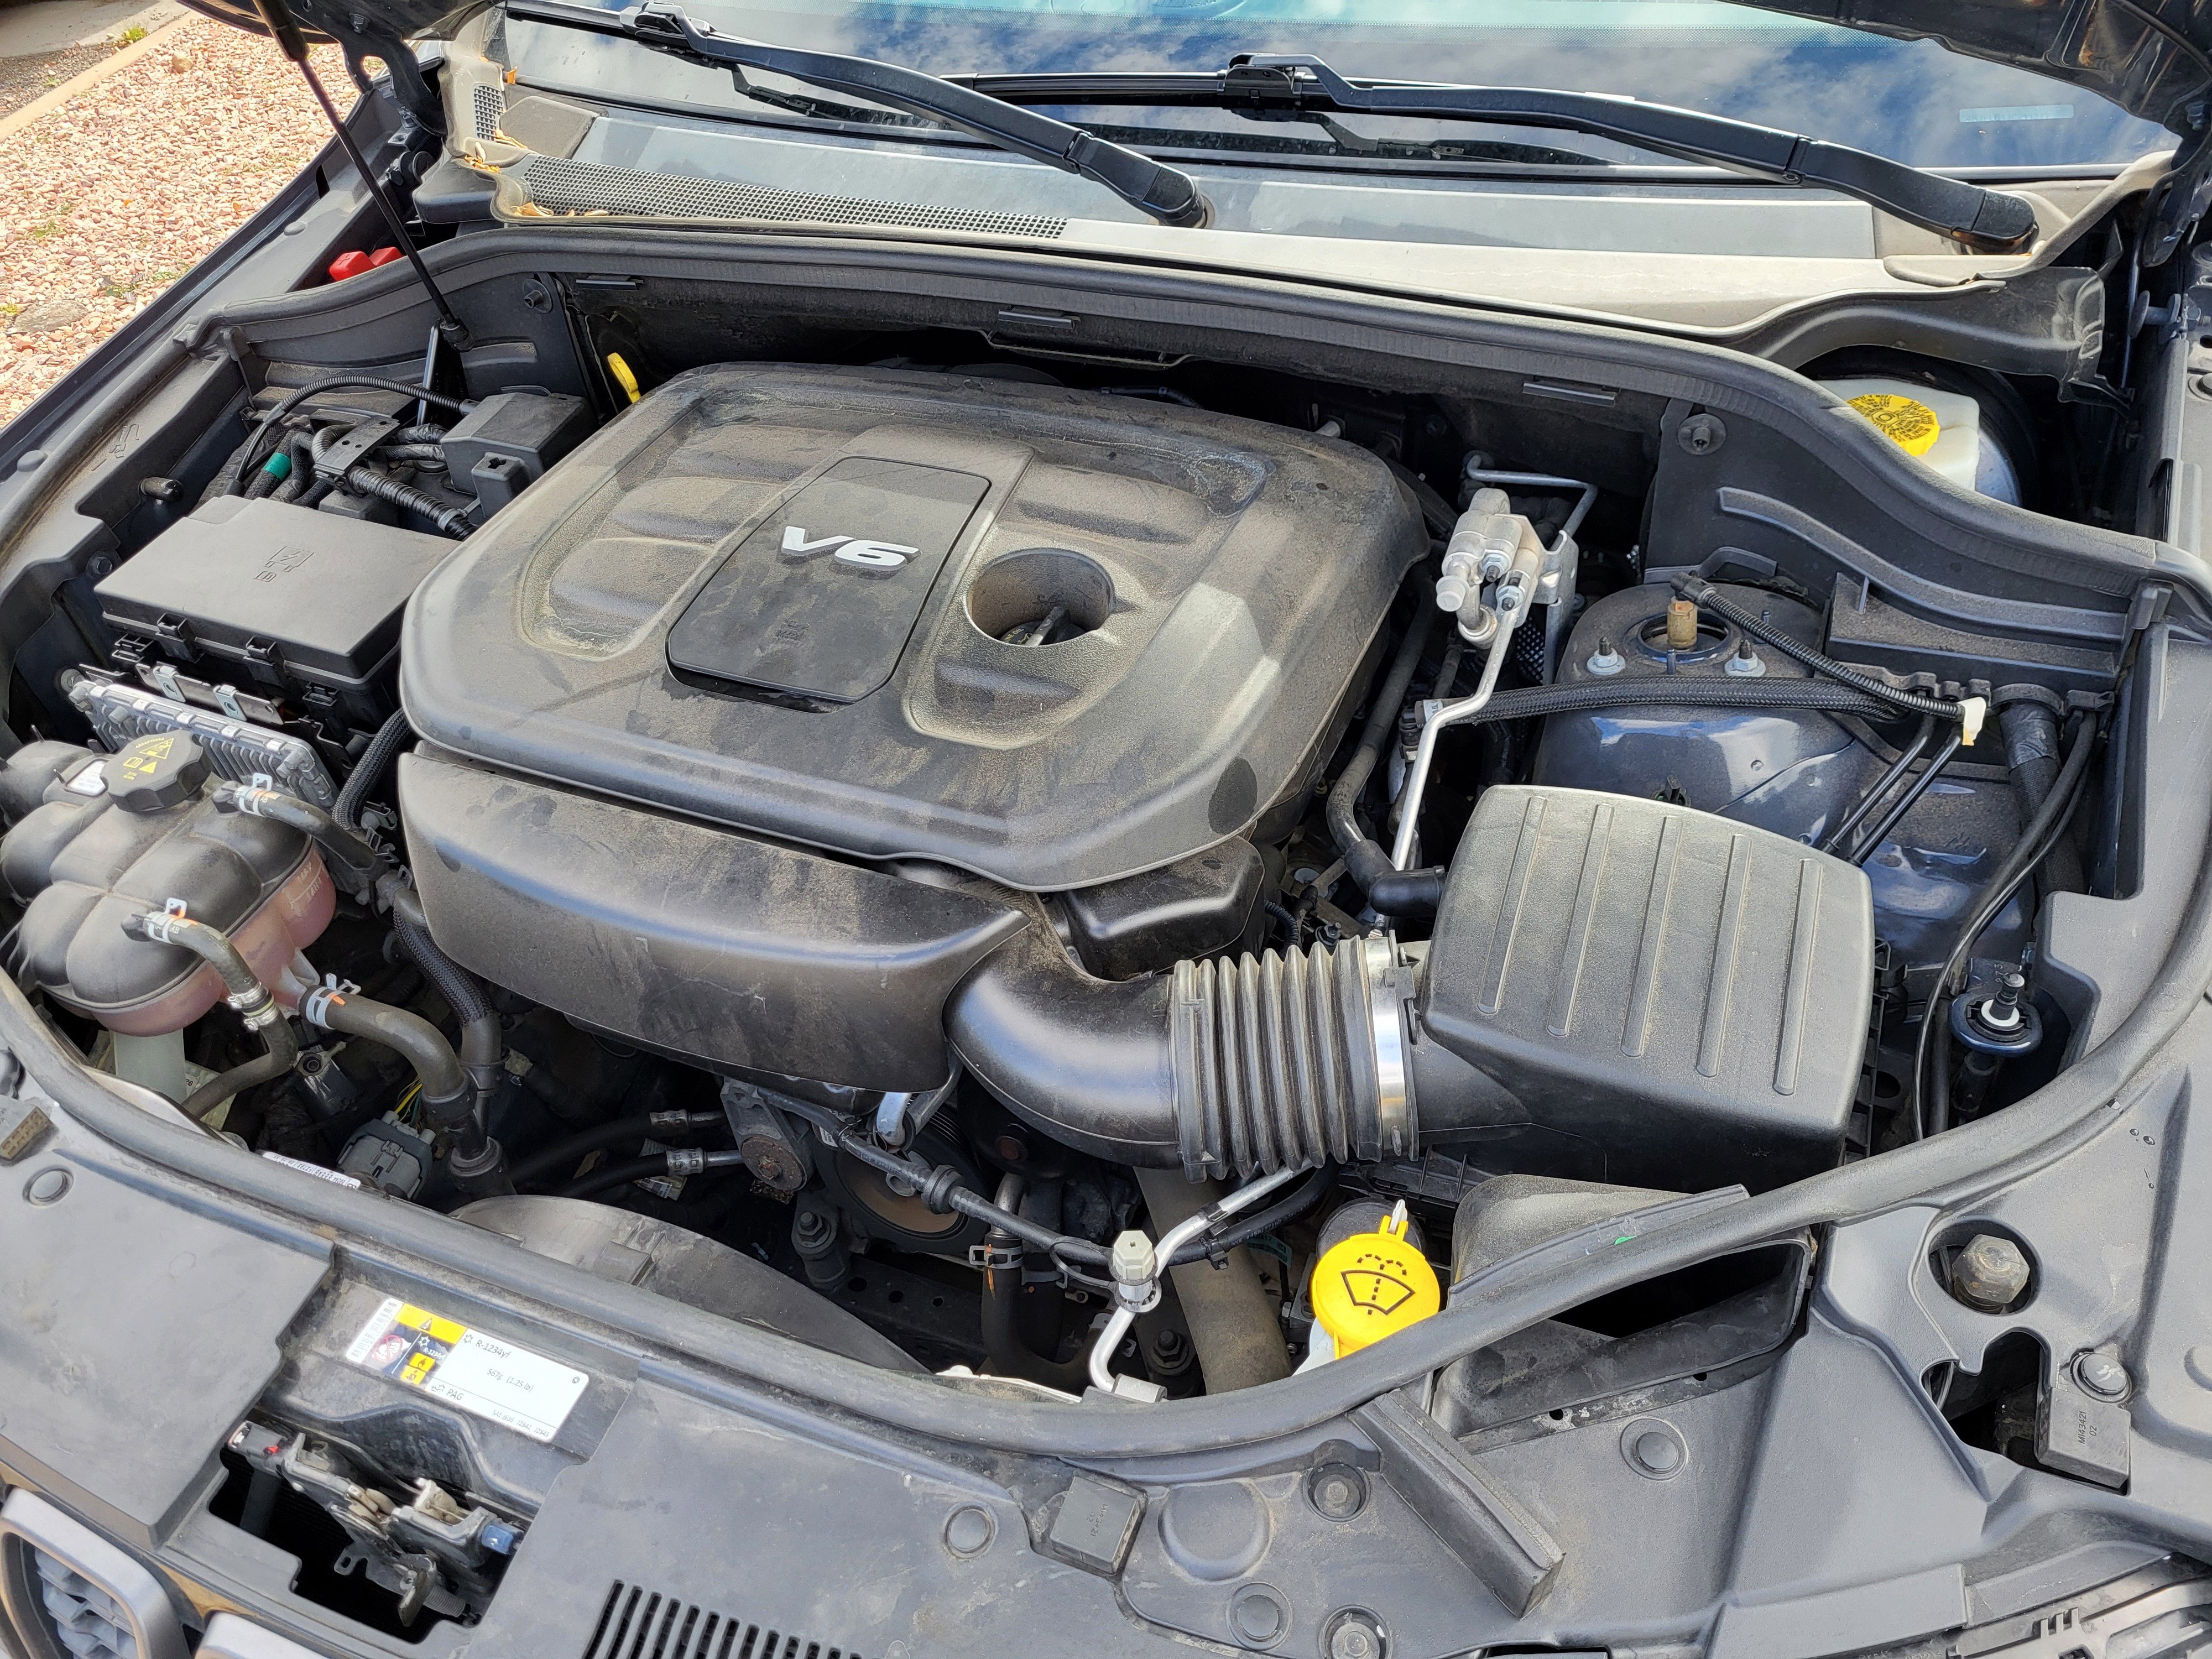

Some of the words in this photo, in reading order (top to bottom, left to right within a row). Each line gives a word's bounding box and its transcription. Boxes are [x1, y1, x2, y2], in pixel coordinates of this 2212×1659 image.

[781, 526, 920, 570] V6
[476, 1339, 512, 1360] R-1234yf
[486, 1368, 502, 1380] 567g
[506, 1375, 523, 1389] (1.25
[446, 1388, 463, 1401] PAG
[492, 1410, 503, 1418] SAE
[2089, 1425, 2098, 1436] 02
